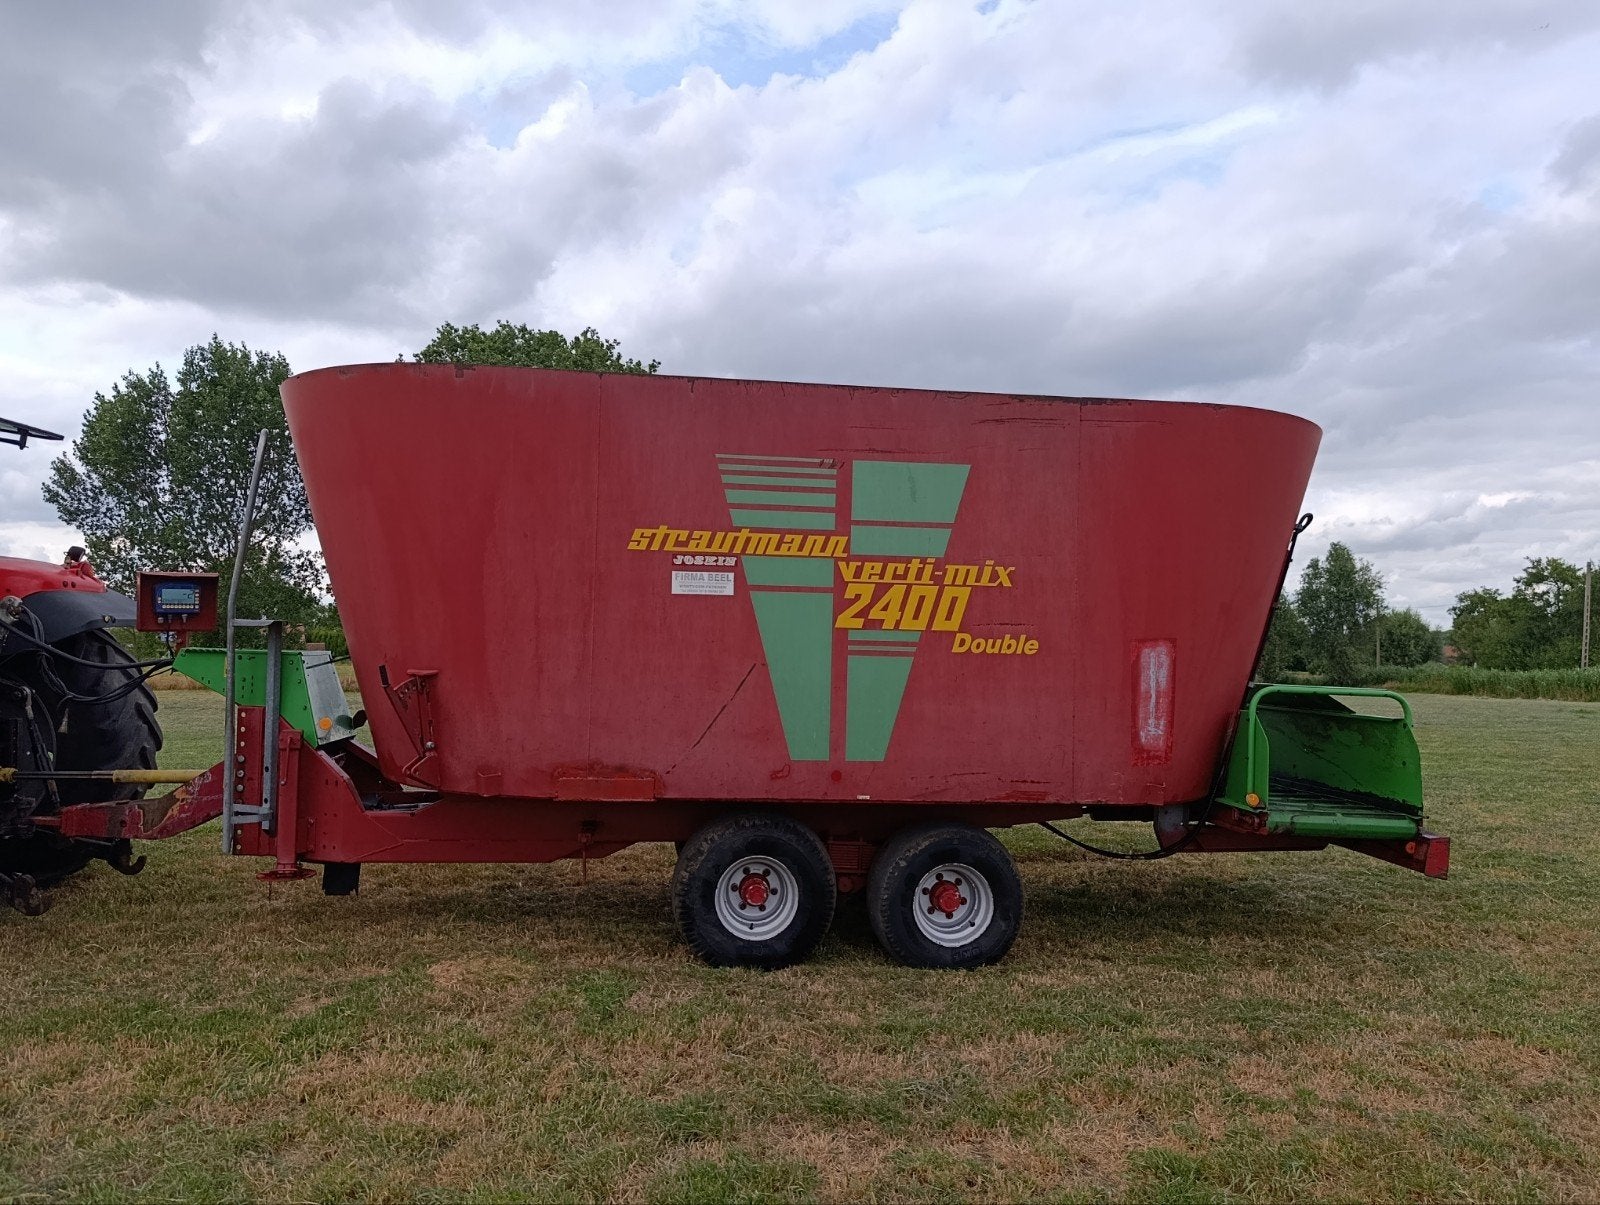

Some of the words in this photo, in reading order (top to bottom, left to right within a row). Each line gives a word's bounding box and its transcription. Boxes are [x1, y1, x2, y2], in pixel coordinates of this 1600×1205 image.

[627, 525, 849, 558] strautmann
[673, 554, 737, 567] JOSKIN
[837, 558, 1016, 587] verti-mix
[675, 572, 705, 581] FIRMA
[708, 573, 732, 582] BEEL
[835, 583, 972, 632] 2400
[951, 633, 1039, 655] Double
